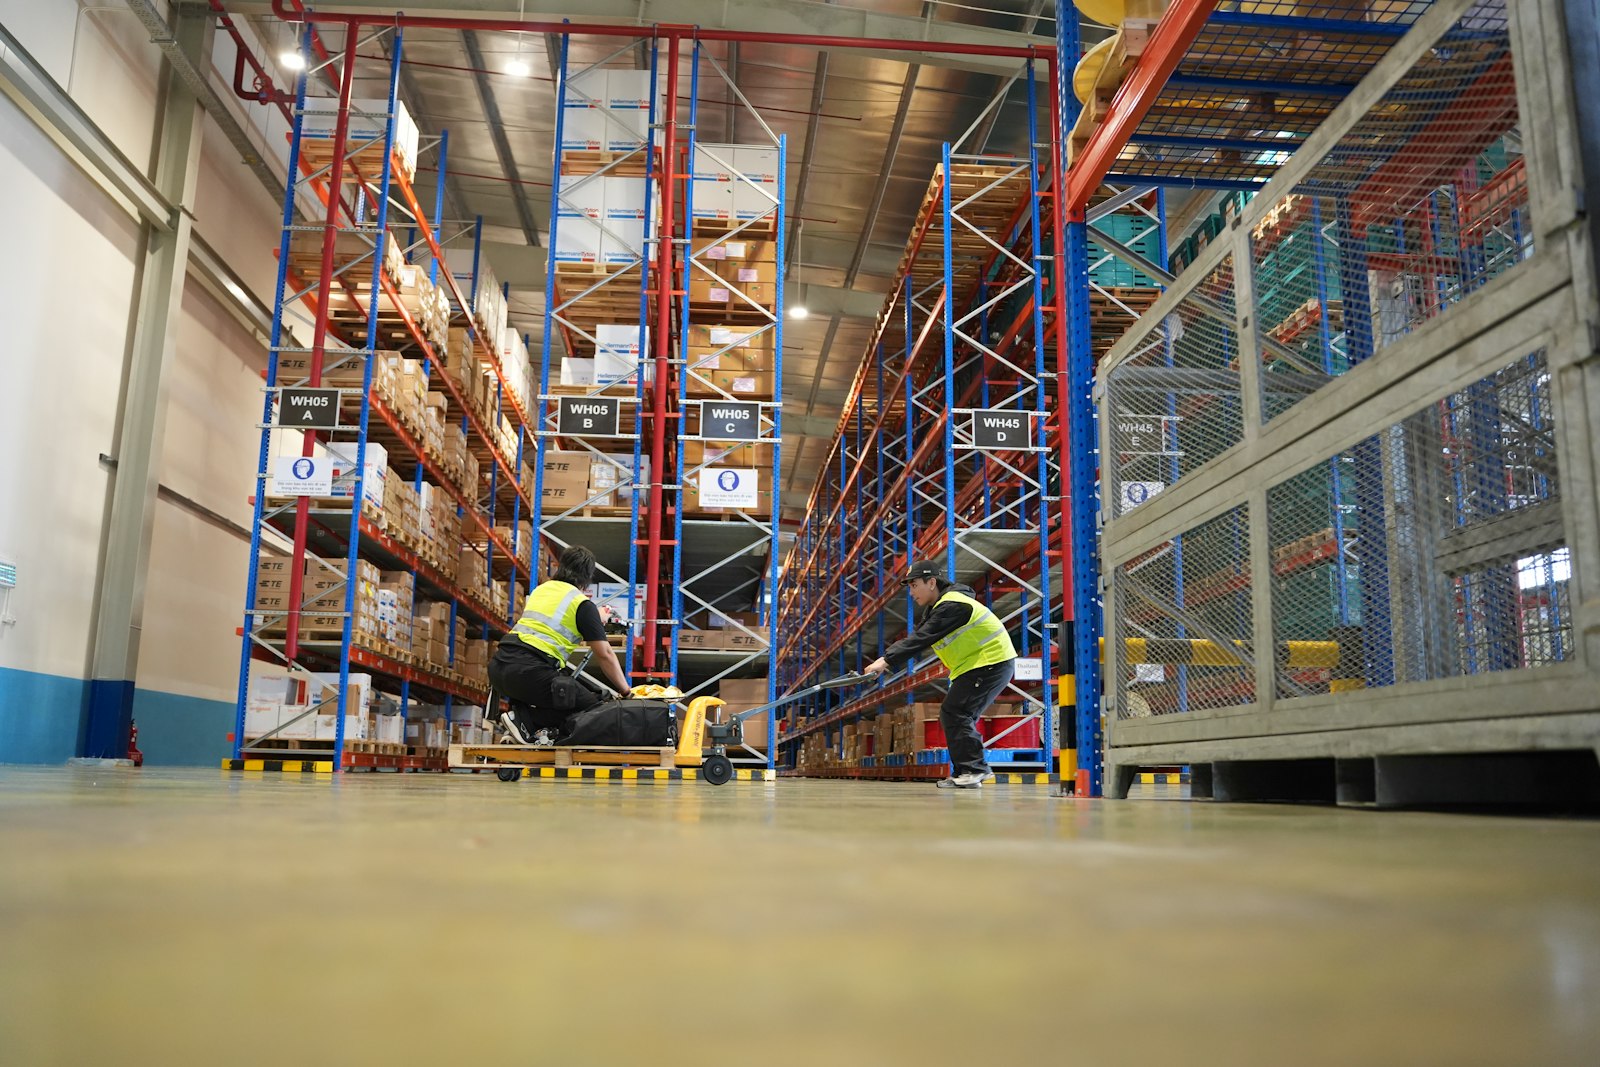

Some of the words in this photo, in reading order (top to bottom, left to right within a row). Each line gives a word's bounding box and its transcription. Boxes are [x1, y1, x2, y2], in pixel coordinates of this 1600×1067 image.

[290, 396, 329, 407] WH05
[302, 410, 313, 420] A
[570, 404, 609, 415] WH05
[712, 408, 750, 420] WH05
[583, 418, 593, 428] B
[725, 422, 735, 433] C
[983, 417, 1020, 428] WH45
[1118, 423, 1154, 433] WH45
[997, 431, 1007, 442] D
[1132, 436, 1140, 446] E
